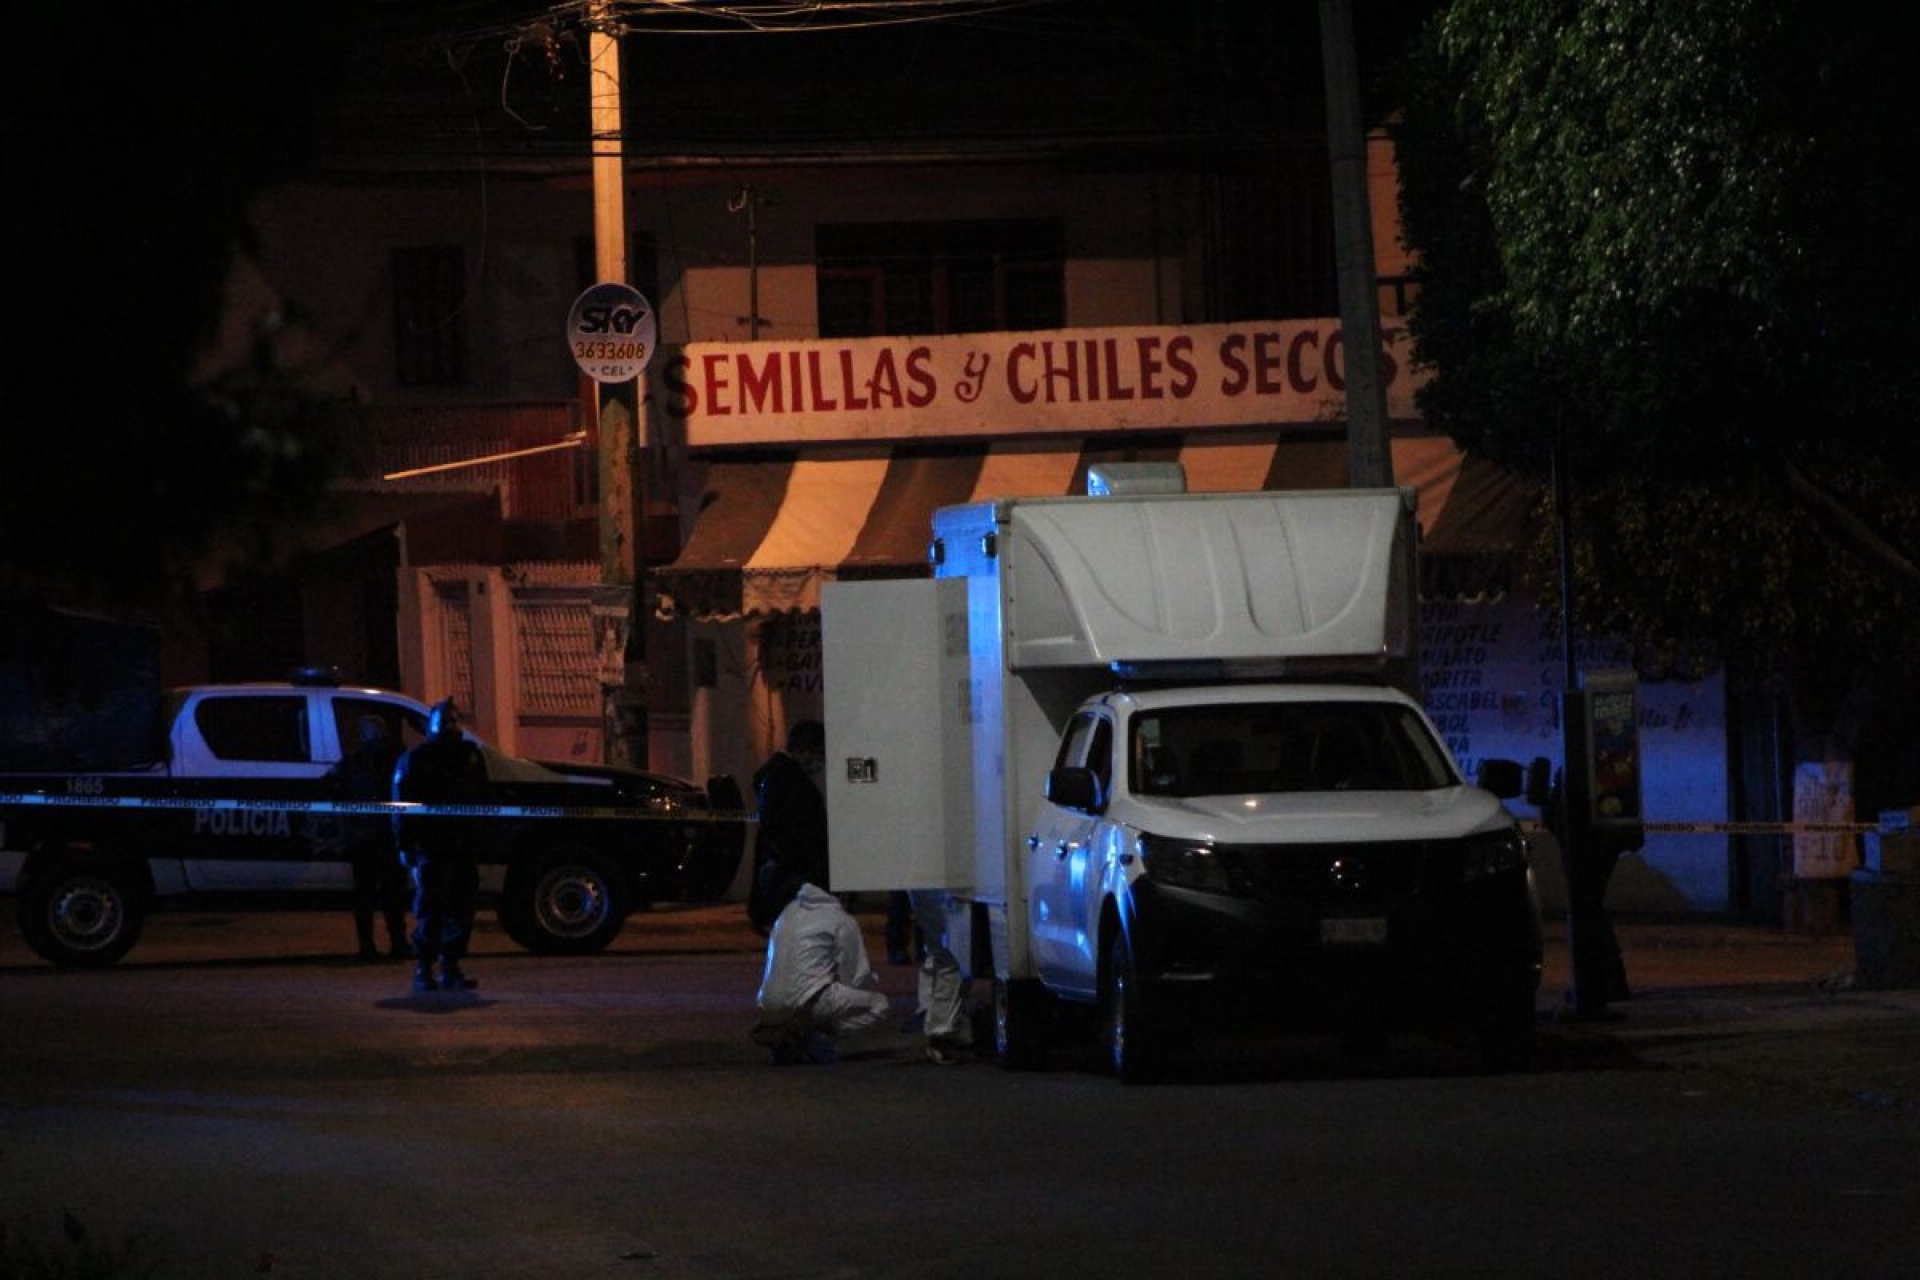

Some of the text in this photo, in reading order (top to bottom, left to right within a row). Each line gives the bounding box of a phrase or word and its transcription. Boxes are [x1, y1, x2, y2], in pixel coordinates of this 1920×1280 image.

[580, 306, 646, 333] SKY
[575, 341, 646, 359] 3633608
[601, 365, 627, 376] CEL
[664, 346, 937, 418] SEMILLAS
[1006, 334, 1198, 404] CHILES
[1420, 623, 1501, 645] HIPOTLE
[1424, 689, 1499, 712] ASCABEL
[66, 776, 103, 794] 1865
[192, 808, 292, 838] POLICIA
